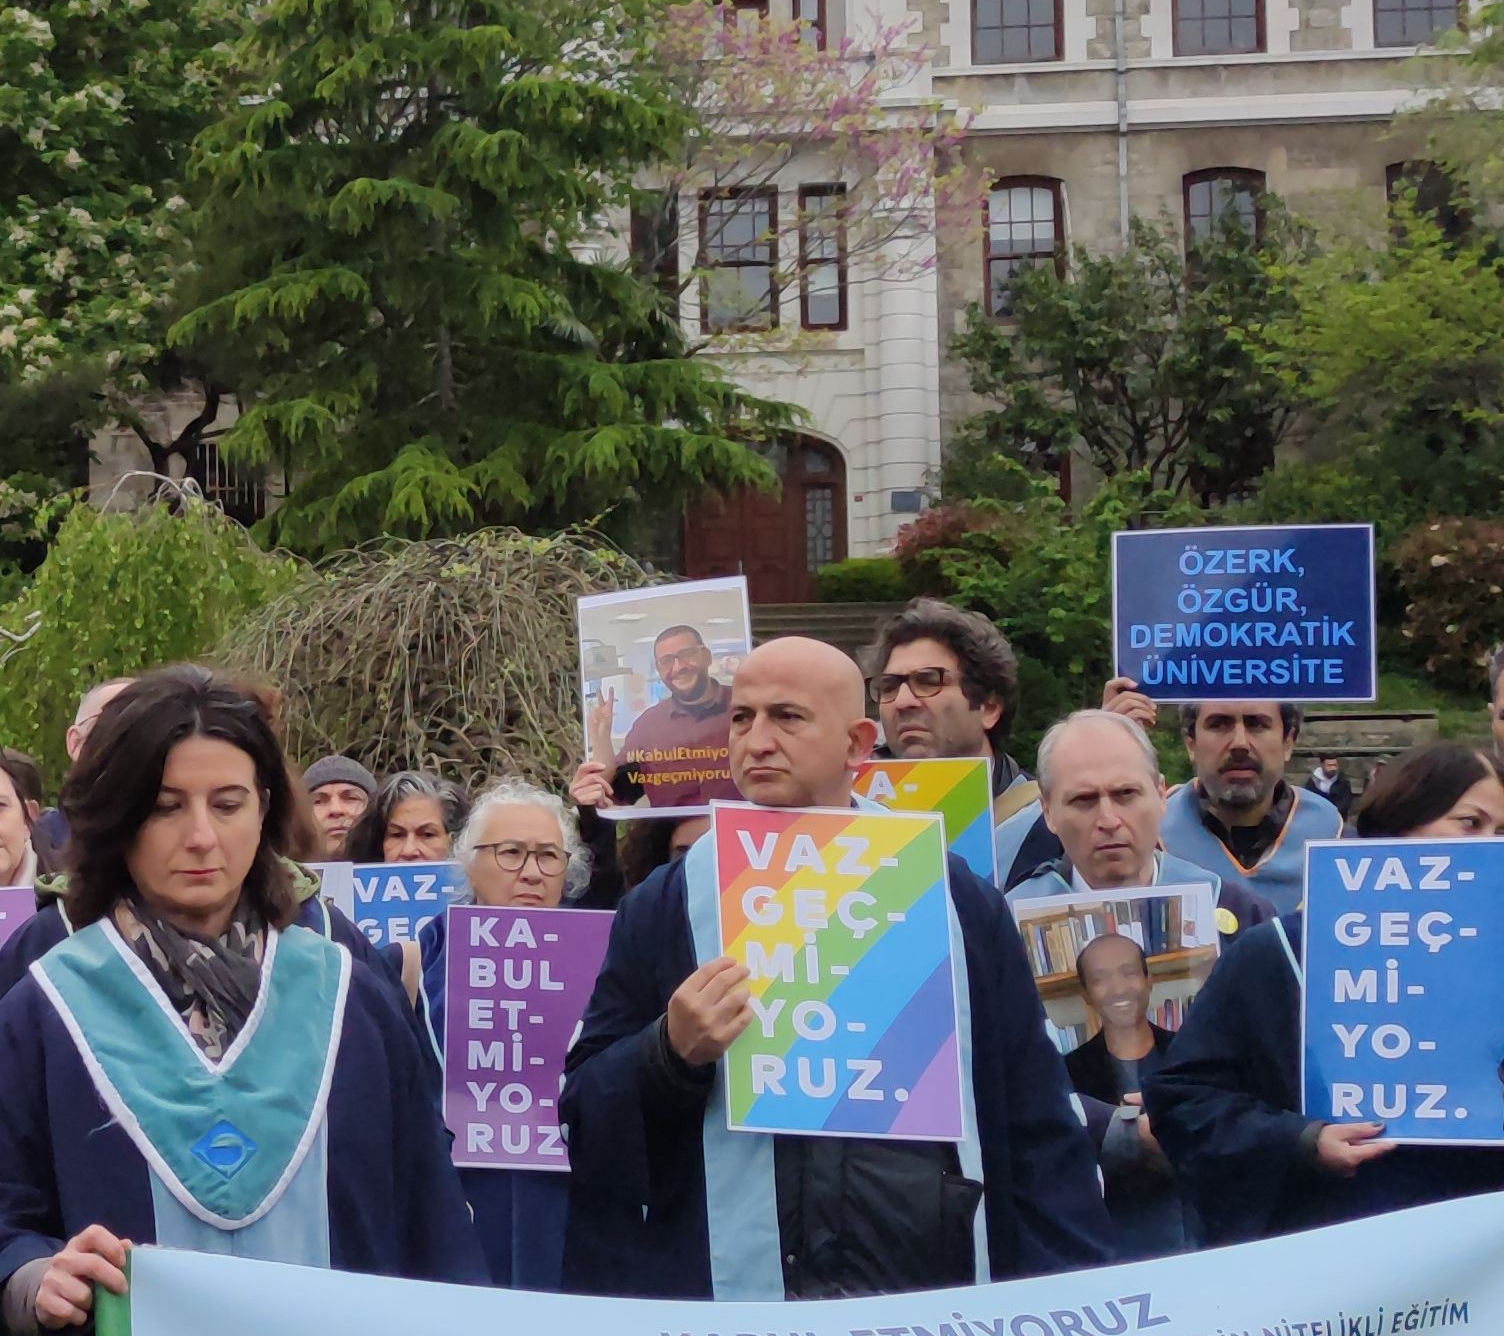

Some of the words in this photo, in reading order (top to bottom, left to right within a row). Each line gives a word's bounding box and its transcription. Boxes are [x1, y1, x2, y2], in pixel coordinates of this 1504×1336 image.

[1178, 544, 1305, 578] ÖZERK,
[1176, 581, 1308, 617] ÖZGÜR,
[1129, 615, 1356, 649] DEMOKRATİK
[1141, 653, 1345, 685] ÜNİVERSİTE
[625, 745, 729, 763] #KabulEtmiyo
[627, 767, 731, 787] Vazgeçmiyoru
[851, 769, 919, 801] A-
[736, 829, 899, 876] VAZ-
[352, 874, 455, 903] VAZ-
[1334, 855, 1475, 891] VAZ-
[740, 885, 906, 939] GEÇ-
[468, 916, 559, 950] KA-
[1334, 911, 1478, 953] GEÇ-
[468, 957, 565, 991] BUL
[744, 931, 850, 984] Mİ-
[1333, 958, 1425, 1004] Mİ-
[467, 998, 544, 1031] ET-
[750, 997, 867, 1041] YO-
[466, 1031, 545, 1072] Mİ-
[1331, 1023, 1436, 1059] YO-
[751, 1053, 910, 1102] RUZ.
[465, 1081, 554, 1115] YO-
[1331, 1083, 1469, 1120] RUZ.
[466, 1122, 565, 1157] RUZ
[1390, 1297, 1470, 1335] EĞİTİM
